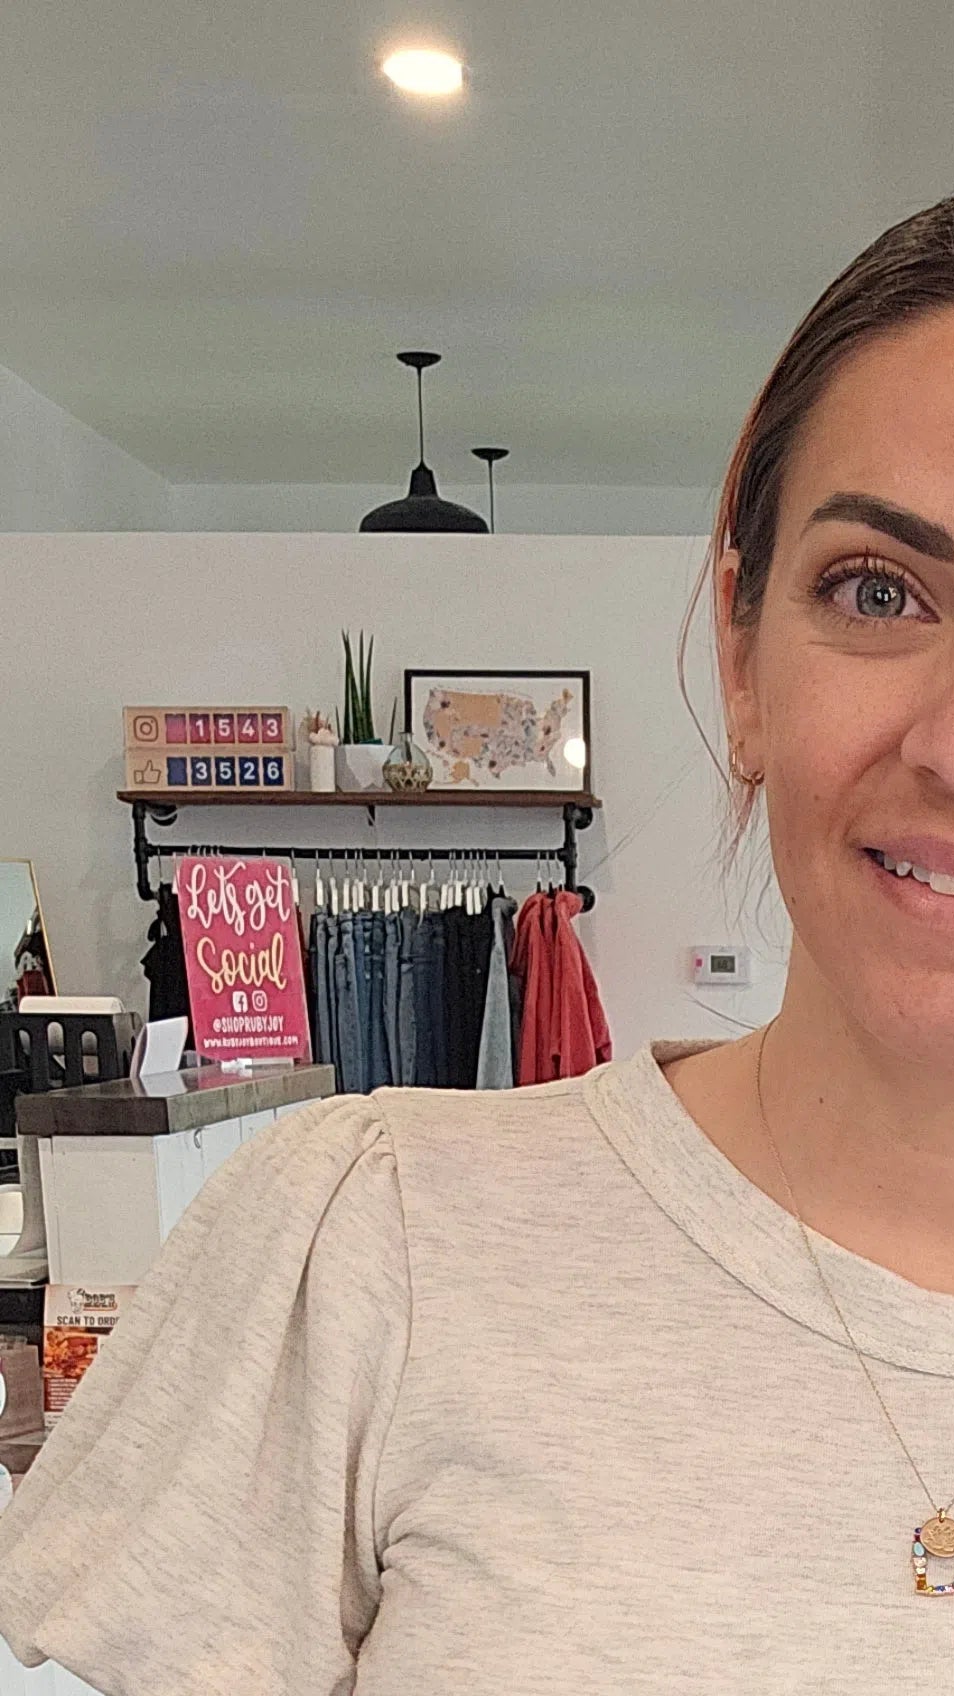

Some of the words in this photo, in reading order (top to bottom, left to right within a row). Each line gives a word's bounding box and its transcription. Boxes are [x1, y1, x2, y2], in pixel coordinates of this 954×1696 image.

[195, 762, 280, 780] 3526
[245, 865, 291, 931] get
[197, 932, 287, 994] Social
[212, 1016, 284, 1033] @SHOPRUBYJOY
[57, 1316, 81, 1326] SCAN
[83, 1316, 95, 1326] TO
